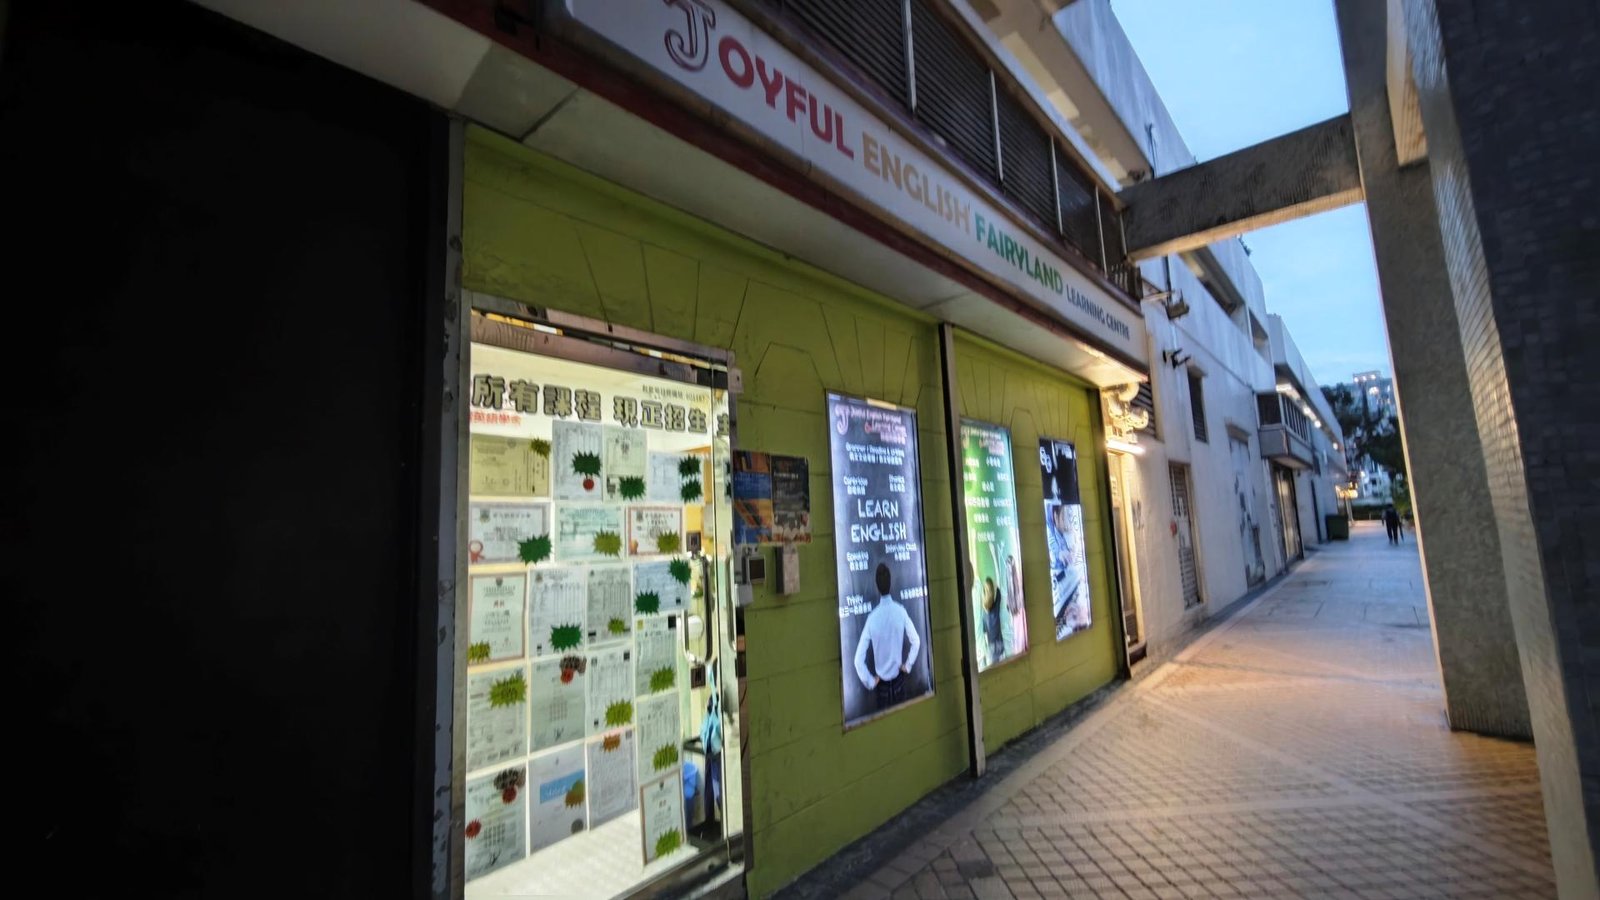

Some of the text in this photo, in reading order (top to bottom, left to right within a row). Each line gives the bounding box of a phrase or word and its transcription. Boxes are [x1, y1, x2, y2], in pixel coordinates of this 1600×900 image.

[664, 0, 1130, 341] JOYFUL ENGLISH FAIRYLAND LEARNING CENTRE
[471, 374, 602, 421] 所有課程
[857, 498, 899, 519] LEARN
[851, 521, 908, 543] ENGLISH
